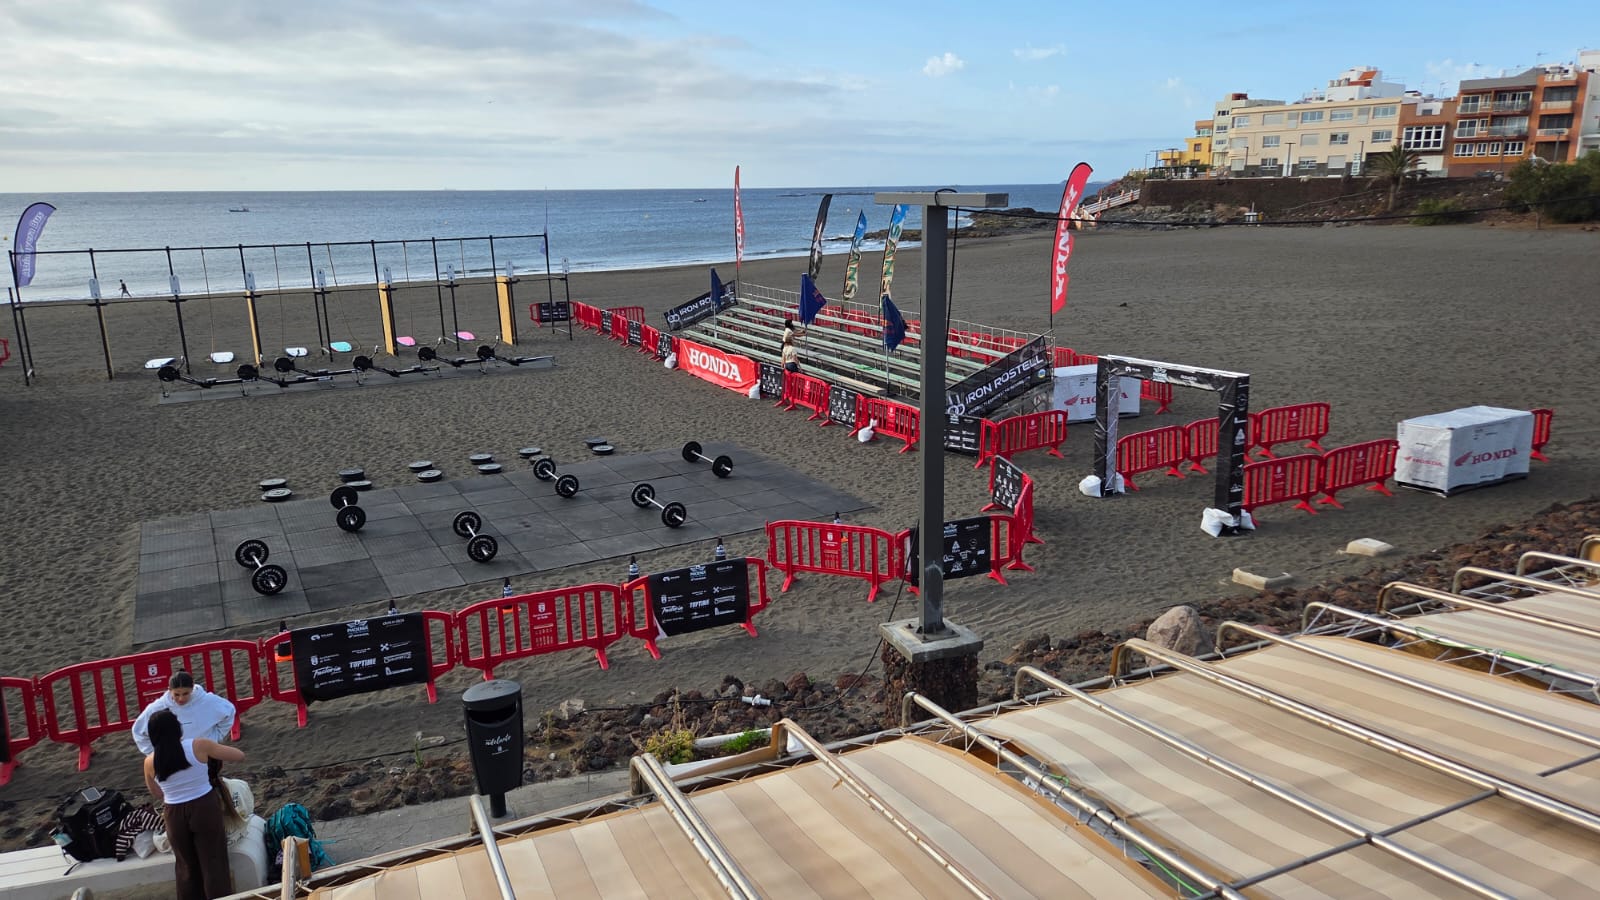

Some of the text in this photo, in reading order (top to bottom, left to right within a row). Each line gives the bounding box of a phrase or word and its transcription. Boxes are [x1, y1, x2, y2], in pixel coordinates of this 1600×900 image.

[680, 302, 699, 316] IRON
[689, 347, 742, 382] HONDA
[965, 383, 993, 405] IRON
[994, 355, 1044, 389] ROSTELL
[1471, 448, 1517, 465] HONDA
